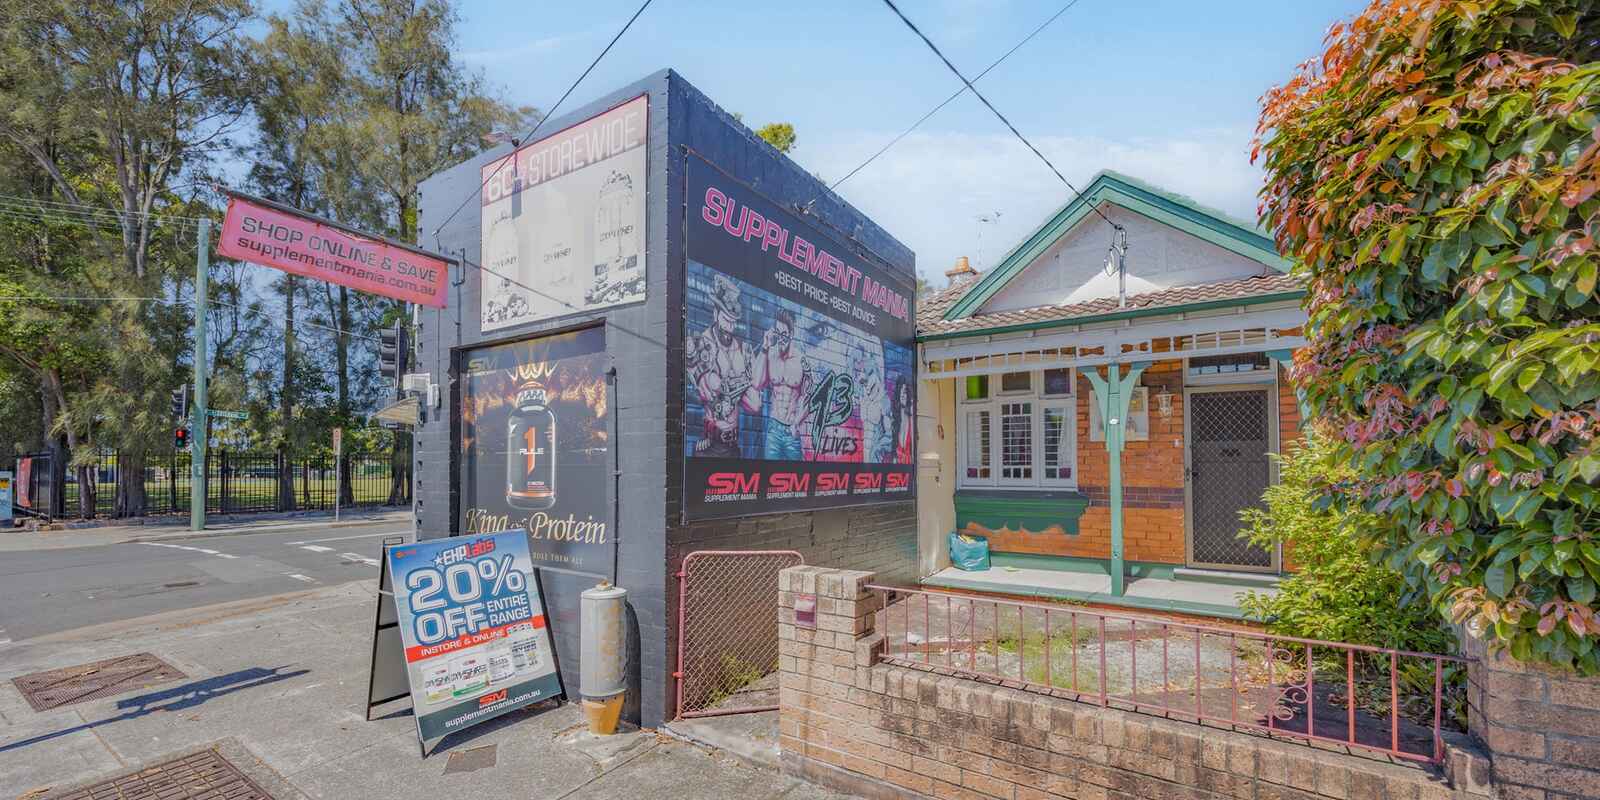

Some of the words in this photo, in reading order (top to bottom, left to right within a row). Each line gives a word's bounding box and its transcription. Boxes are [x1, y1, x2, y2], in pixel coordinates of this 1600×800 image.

[528, 111, 639, 184] STOREWIDE
[241, 216, 303, 243] SHOP
[309, 235, 377, 266] ONLINE
[380, 257, 392, 271] &
[397, 260, 438, 283] SAVE
[702, 186, 862, 296] SUPPLEMENT
[862, 275, 909, 322] MANIA
[237, 236, 437, 296] supplementmania.com.au
[778, 272, 803, 293] BEST
[804, 283, 830, 305] PRICE
[832, 296, 852, 315] BEST
[852, 305, 876, 326] ADVICE
[822, 437, 859, 456] LIVES
[707, 472, 760, 494] SM
[768, 472, 810, 493] SM
[816, 472, 849, 491] SM
[854, 472, 882, 489] SM
[886, 472, 910, 488] SM
[704, 493, 740, 503] SUPPLEMENT
[529, 511, 608, 545] Protein
[408, 554, 524, 613] 20%
[487, 594, 528, 612] ENTIRE
[415, 602, 487, 644] OFF
[490, 606, 530, 626] RANGE
[420, 638, 462, 656] INSTORE
[445, 689, 541, 728] supplementmania.com.au
